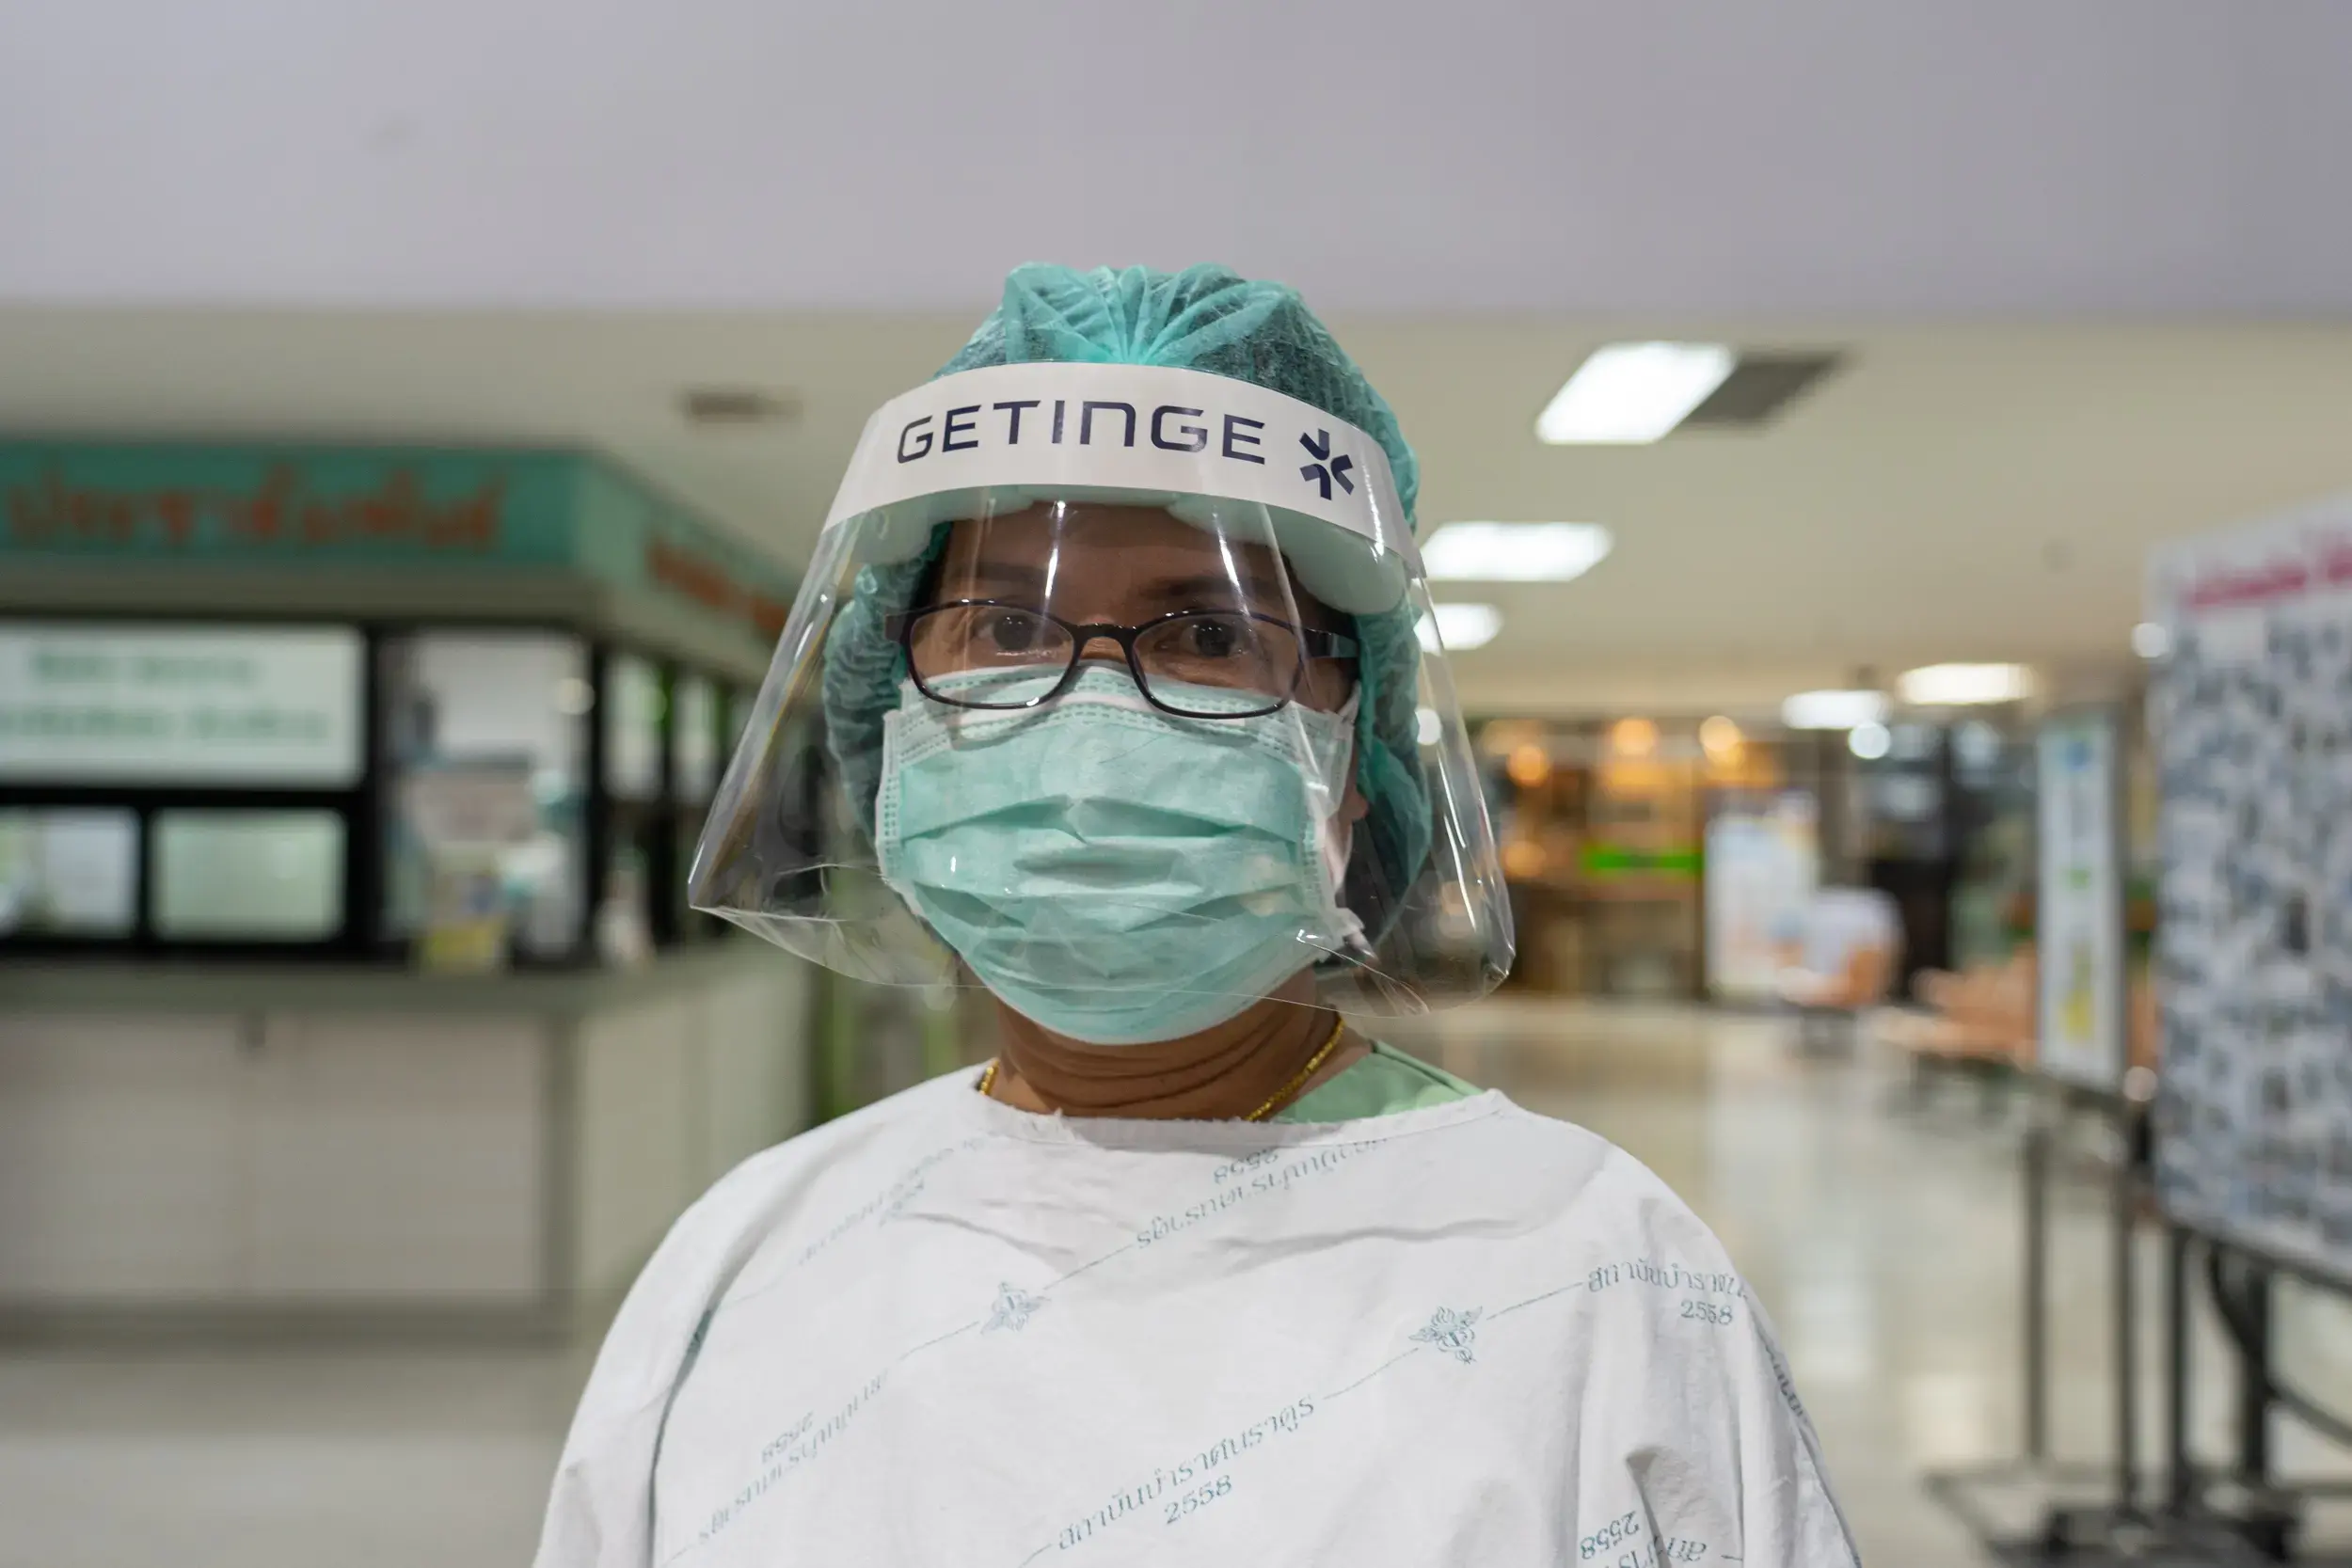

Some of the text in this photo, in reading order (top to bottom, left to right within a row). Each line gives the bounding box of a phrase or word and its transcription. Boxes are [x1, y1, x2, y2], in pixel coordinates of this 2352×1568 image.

[897, 399, 1266, 466] GETINGE
[1680, 1299, 1734, 1326] 2558
[1164, 1473, 1233, 1526] 2558
[1579, 1511, 1641, 1560] 2558
